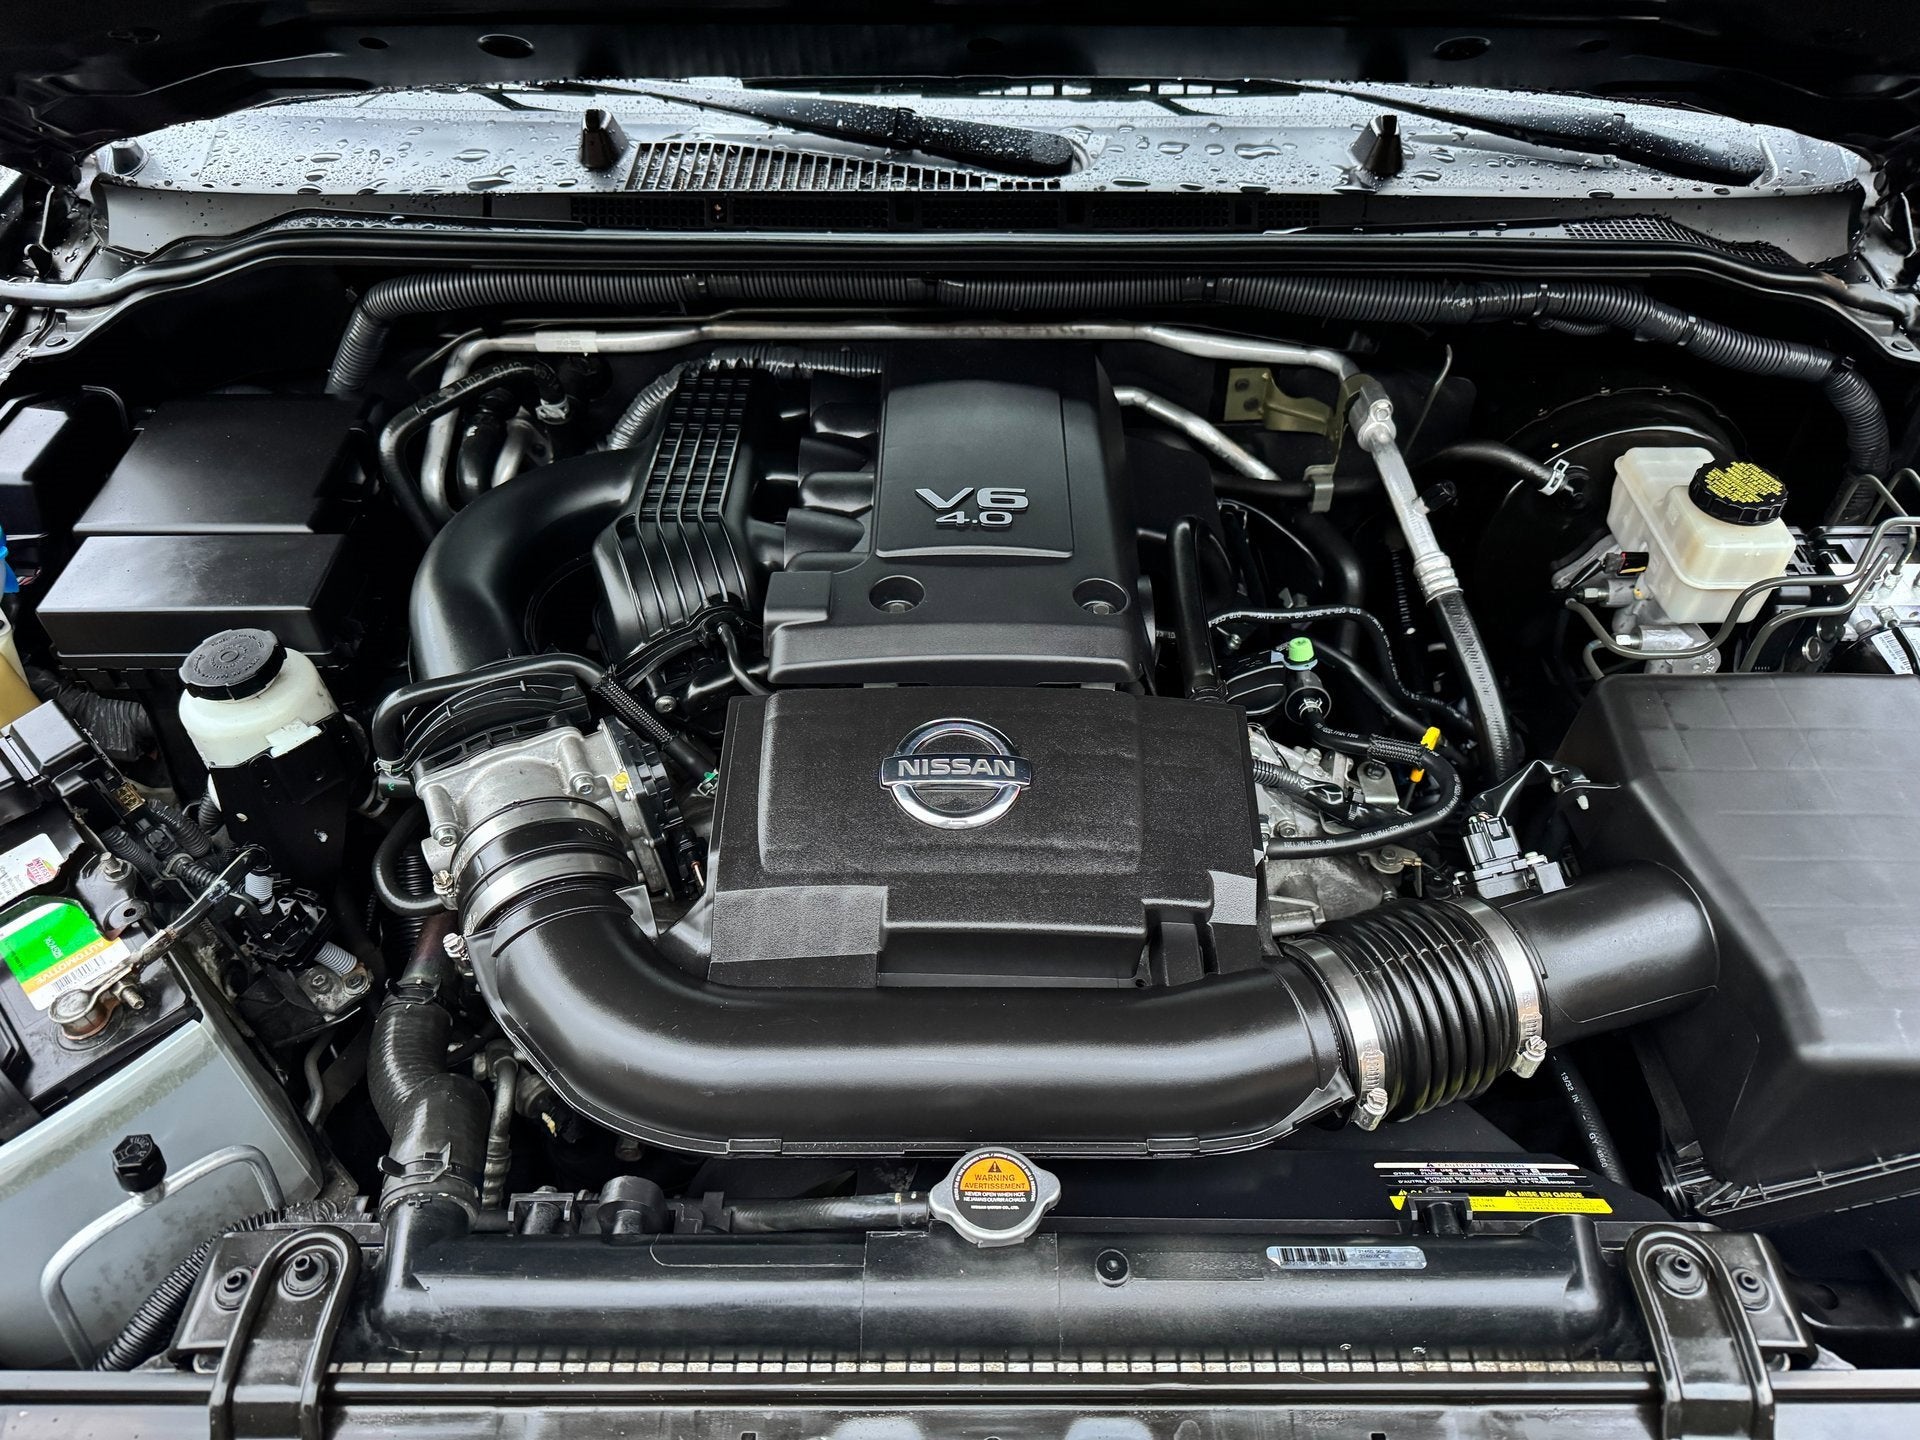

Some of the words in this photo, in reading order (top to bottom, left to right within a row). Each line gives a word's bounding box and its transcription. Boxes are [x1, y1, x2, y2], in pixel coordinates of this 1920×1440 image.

[915, 487, 1029, 511] V6
[935, 510, 1013, 527] 4.0
[898, 758, 1016, 777] NISSAN
[35, 940, 106, 984] AUTOMOTIVE
[1560, 1071, 1574, 1092] 13/32
[1571, 1093, 1580, 1104] IN
[1588, 1132, 1600, 1145] GY
[964, 1182, 1026, 1190] AVERTISSEMENT
[974, 1174, 1016, 1182] WARNING
[1553, 1191, 1584, 1199] GARDE
